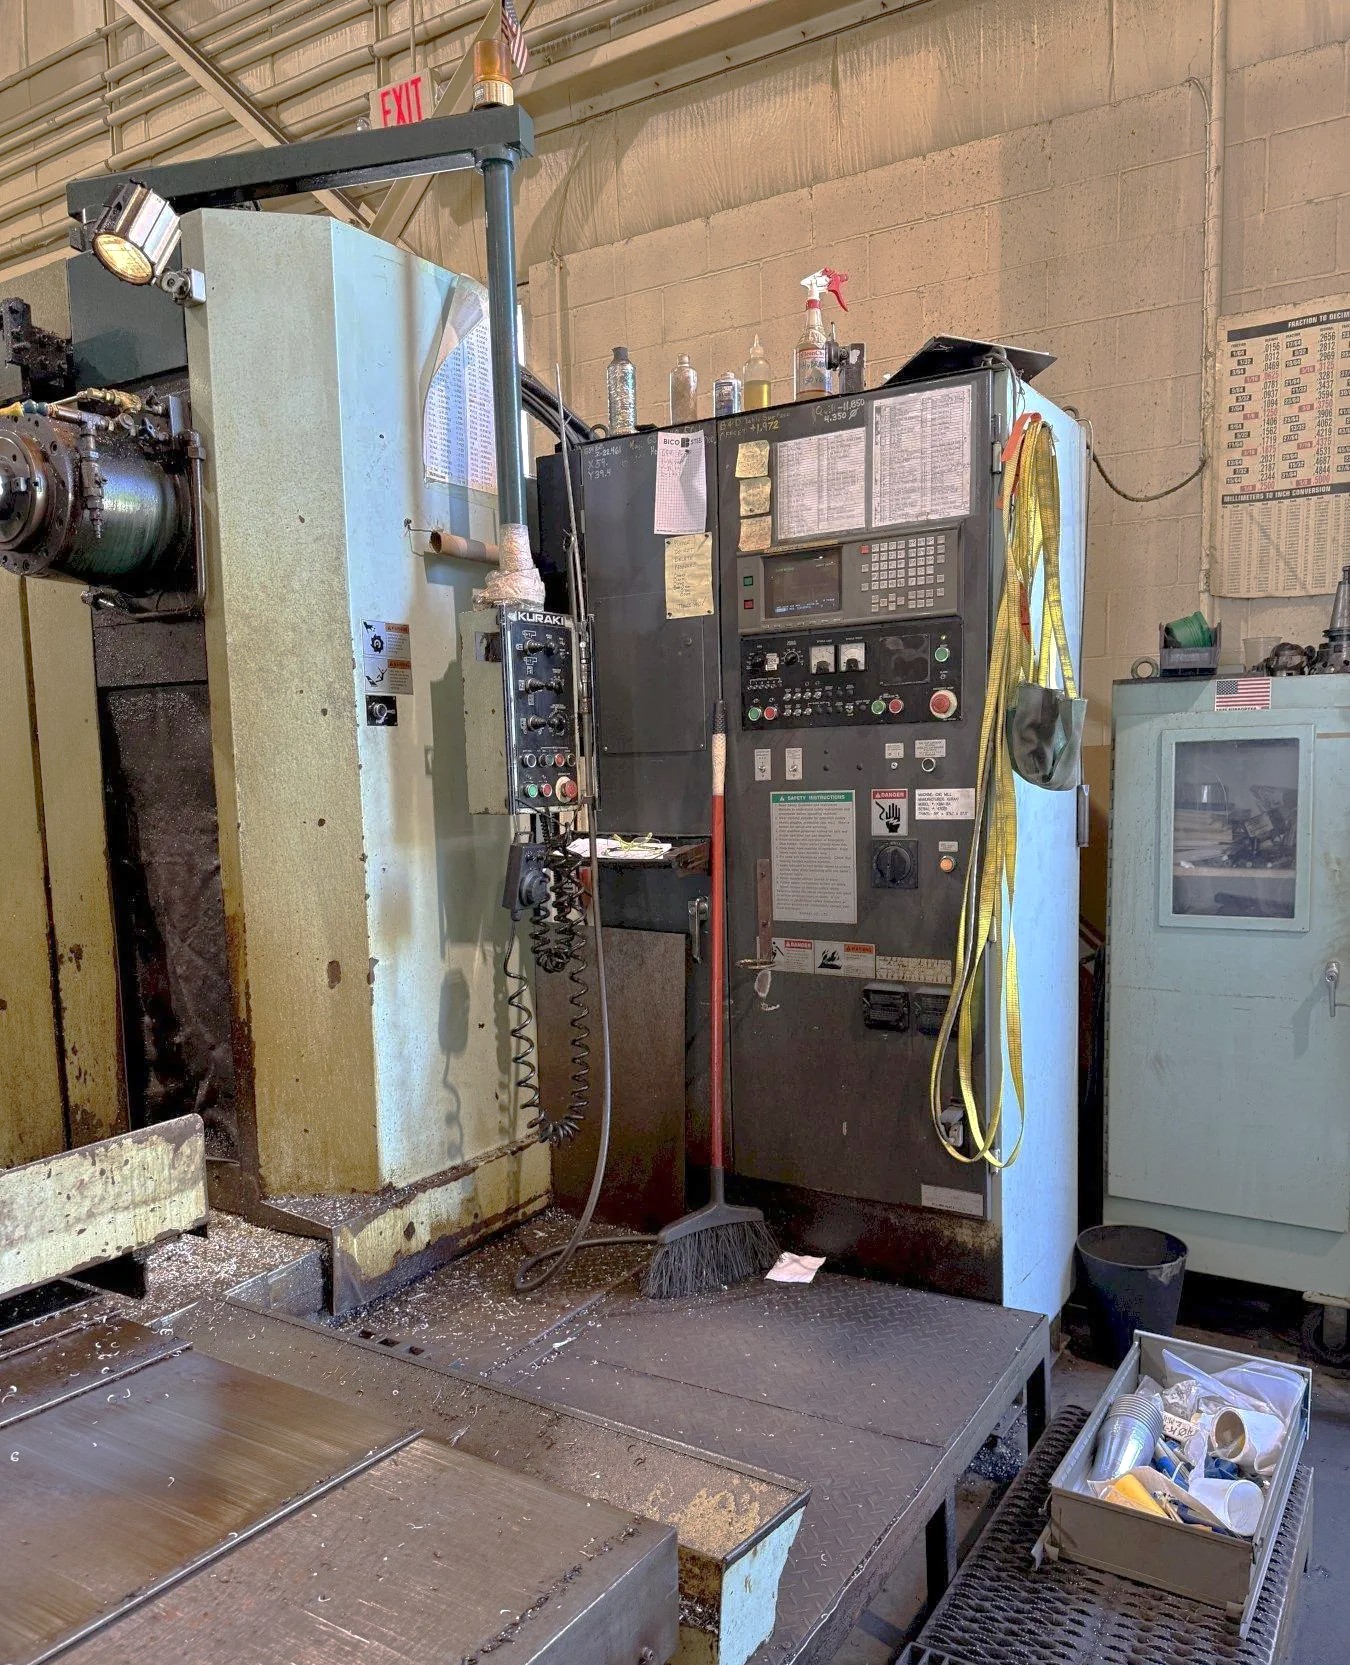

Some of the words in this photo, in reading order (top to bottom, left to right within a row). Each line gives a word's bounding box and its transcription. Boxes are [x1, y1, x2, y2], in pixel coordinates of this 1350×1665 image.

[380, 76, 424, 128] EXIT
[1288, 316, 1317, 328] FRACTION
[1320, 314, 1327, 322] TO
[1330, 312, 1350, 320] DECIM
[1264, 342, 1280, 352] .0156
[1318, 332, 1335, 343] .2656
[1263, 352, 1279, 363] .0312
[1318, 341, 1335, 352] .2812
[1263, 361, 1279, 371] .0469
[1317, 351, 1334, 362] .2969
[1262, 380, 1278, 390] .0781
[1317, 370, 1333, 381] .3281
[1262, 389, 1278, 399] .0937
[1316, 380, 1333, 391] .3437
[1261, 398, 1277, 408] .1094
[1316, 390, 1333, 400] .3594
[1260, 426, 1277, 436] .1562
[1315, 418, 1332, 428] .4062
[1261, 417, 1277, 427] .1406
[1315, 409, 1332, 419] .3906
[1260, 436, 1276, 445] .1719
[1315, 427, 1332, 438] .4219
[1259, 463, 1275, 472] .2187
[1314, 456, 1330, 466] .4687
[1260, 454, 1275, 463] .2031
[1314, 447, 1330, 456] .4531
[1259, 472, 1275, 481] .2344
[1313, 465, 1330, 475] .4844
[1224, 492, 1263, 502] MILLIMETERS
[1292, 486, 1330, 496] CONVERSION
[518, 611, 564, 625] KURAKI
